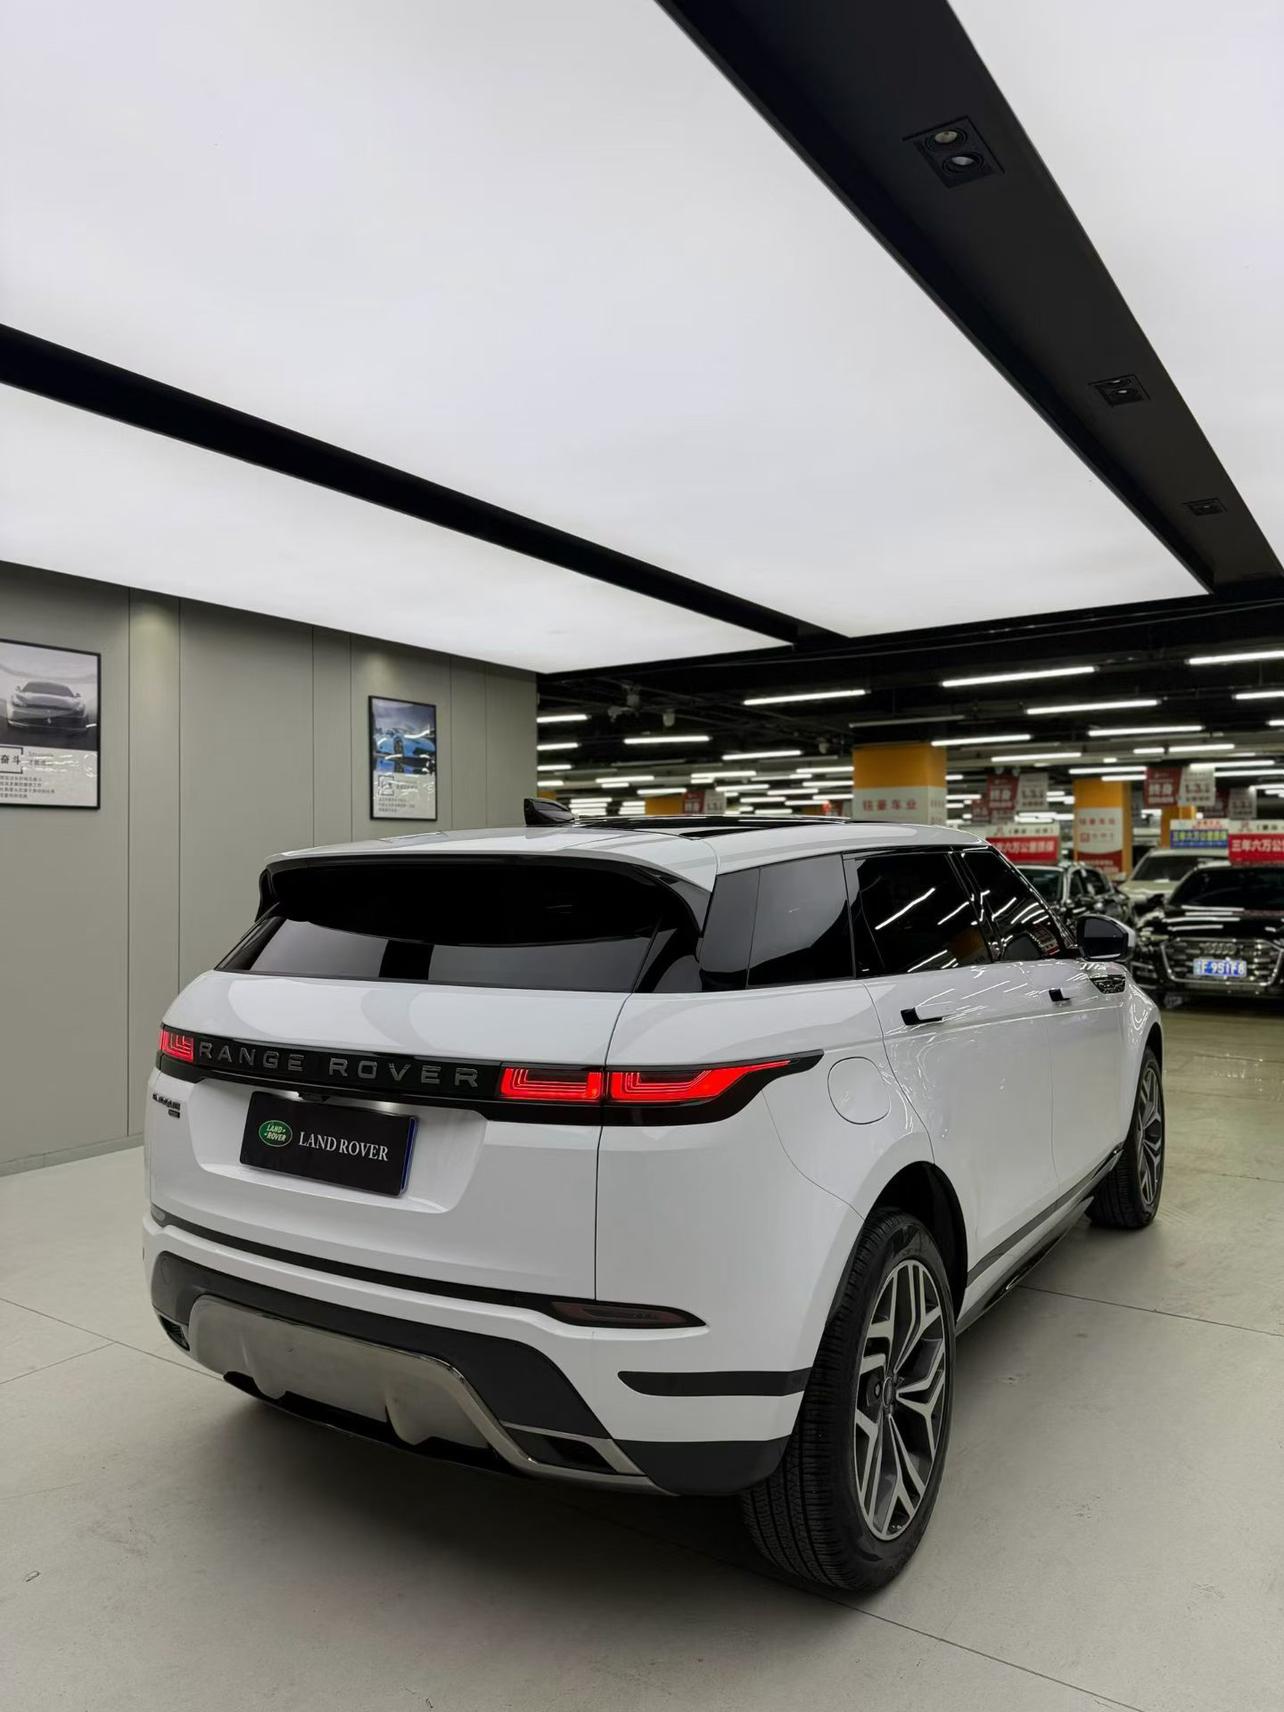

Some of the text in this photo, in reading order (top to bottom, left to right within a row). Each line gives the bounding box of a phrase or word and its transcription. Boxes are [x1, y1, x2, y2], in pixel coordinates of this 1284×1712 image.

[1231, 839, 1284, 852] 三年六万公
[199, 1040, 478, 1088] RANGE ROVER
[266, 1124, 284, 1133] LAND
[266, 1131, 287, 1142] ROVER
[298, 1131, 389, 1162] LAND ROVER
